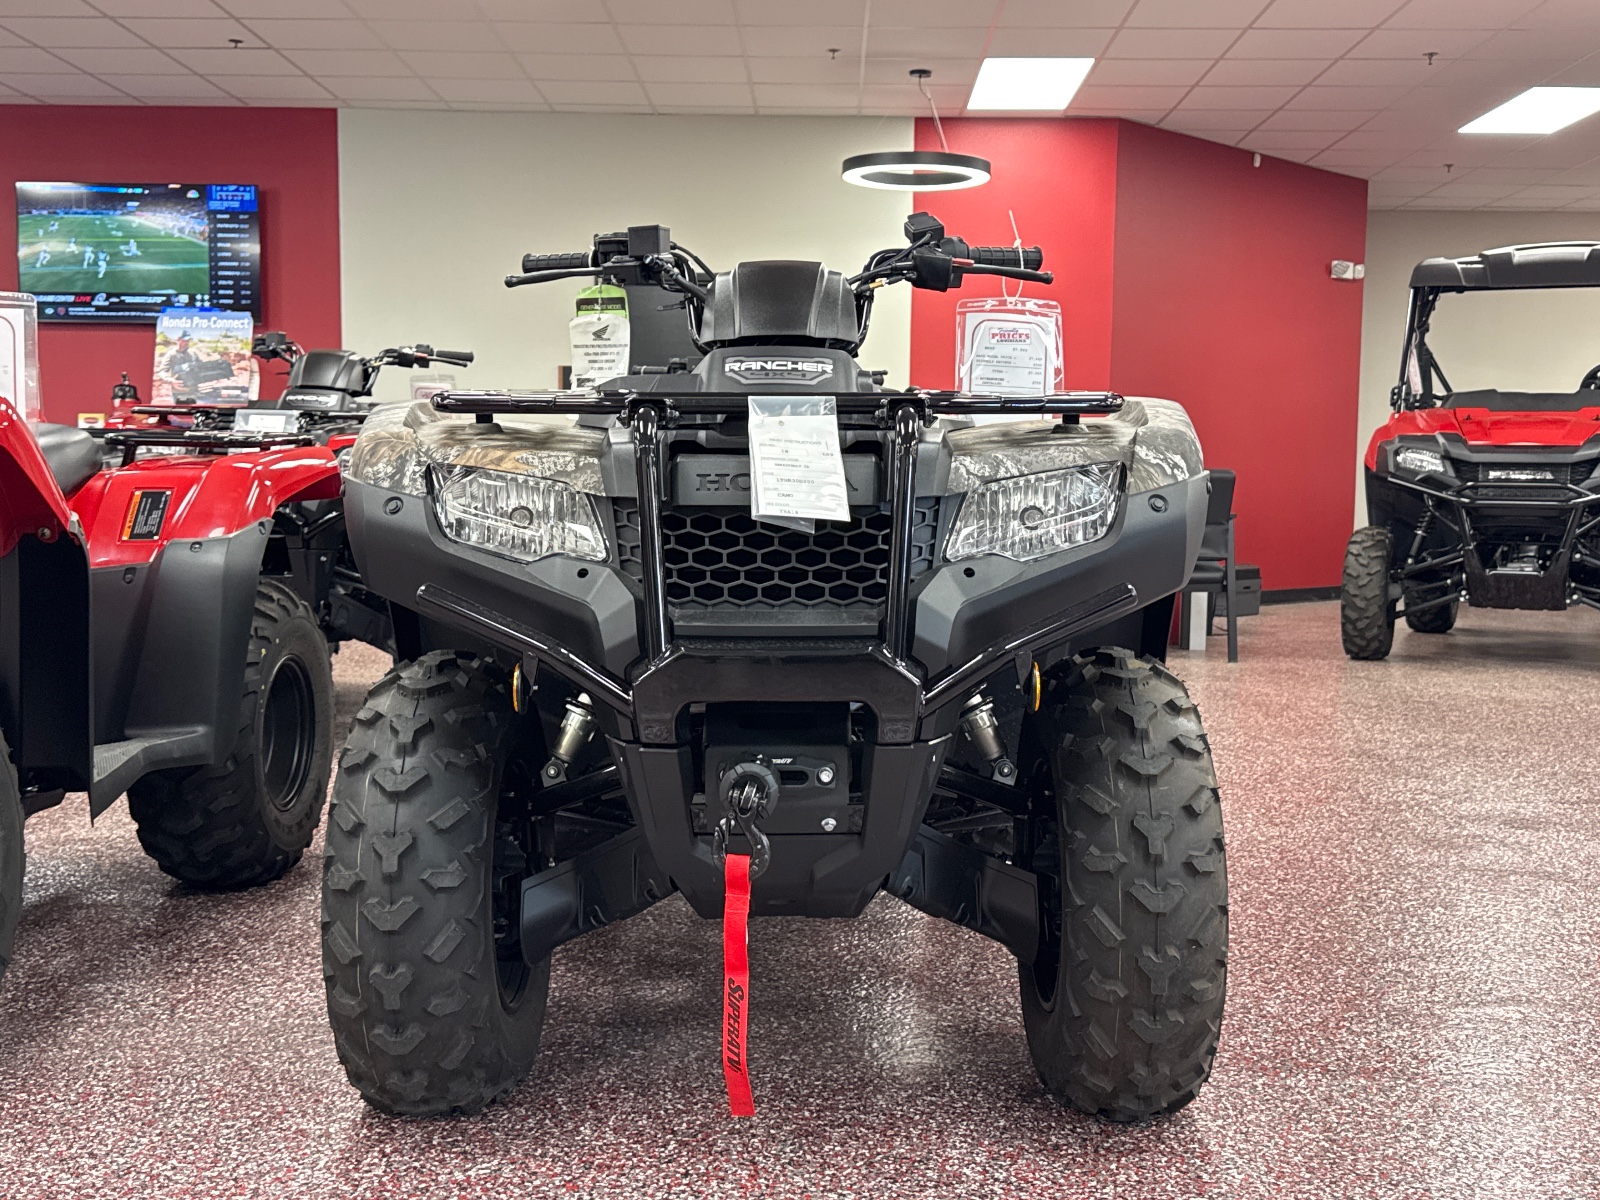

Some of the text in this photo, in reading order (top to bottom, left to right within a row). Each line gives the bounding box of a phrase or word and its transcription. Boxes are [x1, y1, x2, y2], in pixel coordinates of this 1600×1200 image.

[162, 316, 249, 329] Honda Pro-Connect
[991, 332, 1030, 340] PRICES
[724, 361, 834, 373] RANCHER
